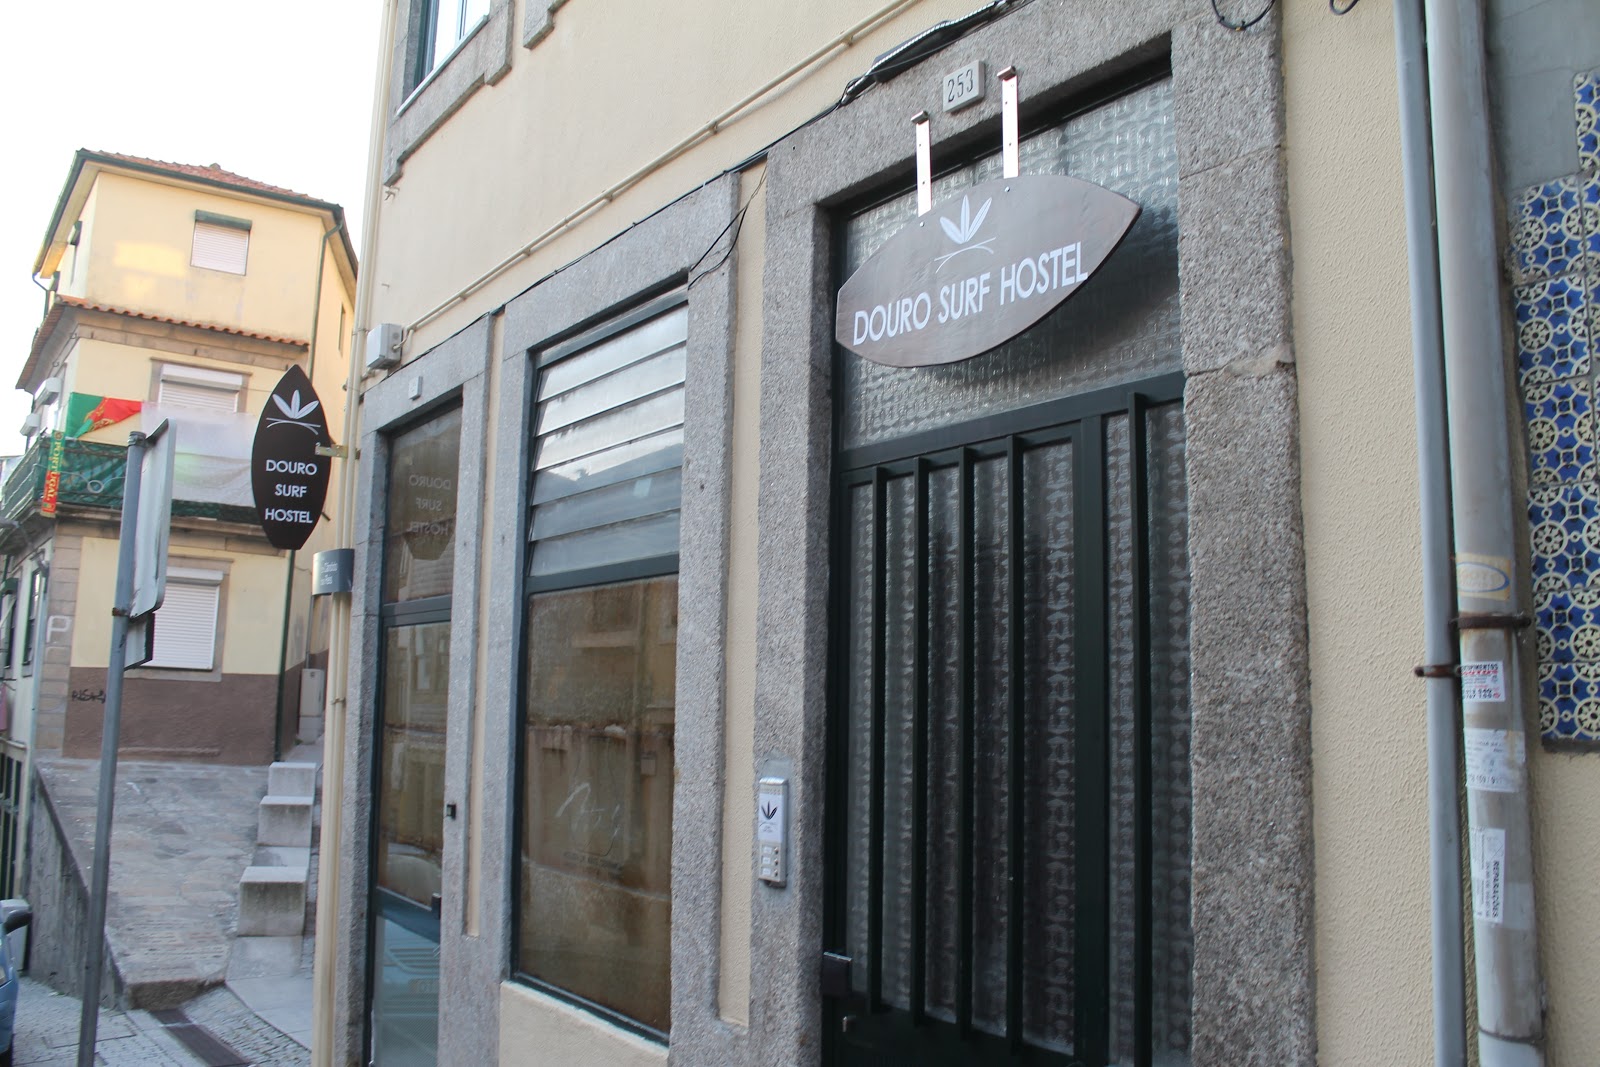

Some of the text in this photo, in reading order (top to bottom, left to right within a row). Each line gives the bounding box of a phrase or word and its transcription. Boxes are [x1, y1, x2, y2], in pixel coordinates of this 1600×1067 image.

[947, 69, 974, 103] 253
[853, 241, 1089, 346] DOURO SURF HOSTEL
[47, 441, 62, 501] PORTUGAL
[265, 459, 318, 476] DOURO
[274, 483, 308, 498] SURF
[264, 507, 314, 524] HOSTEL
